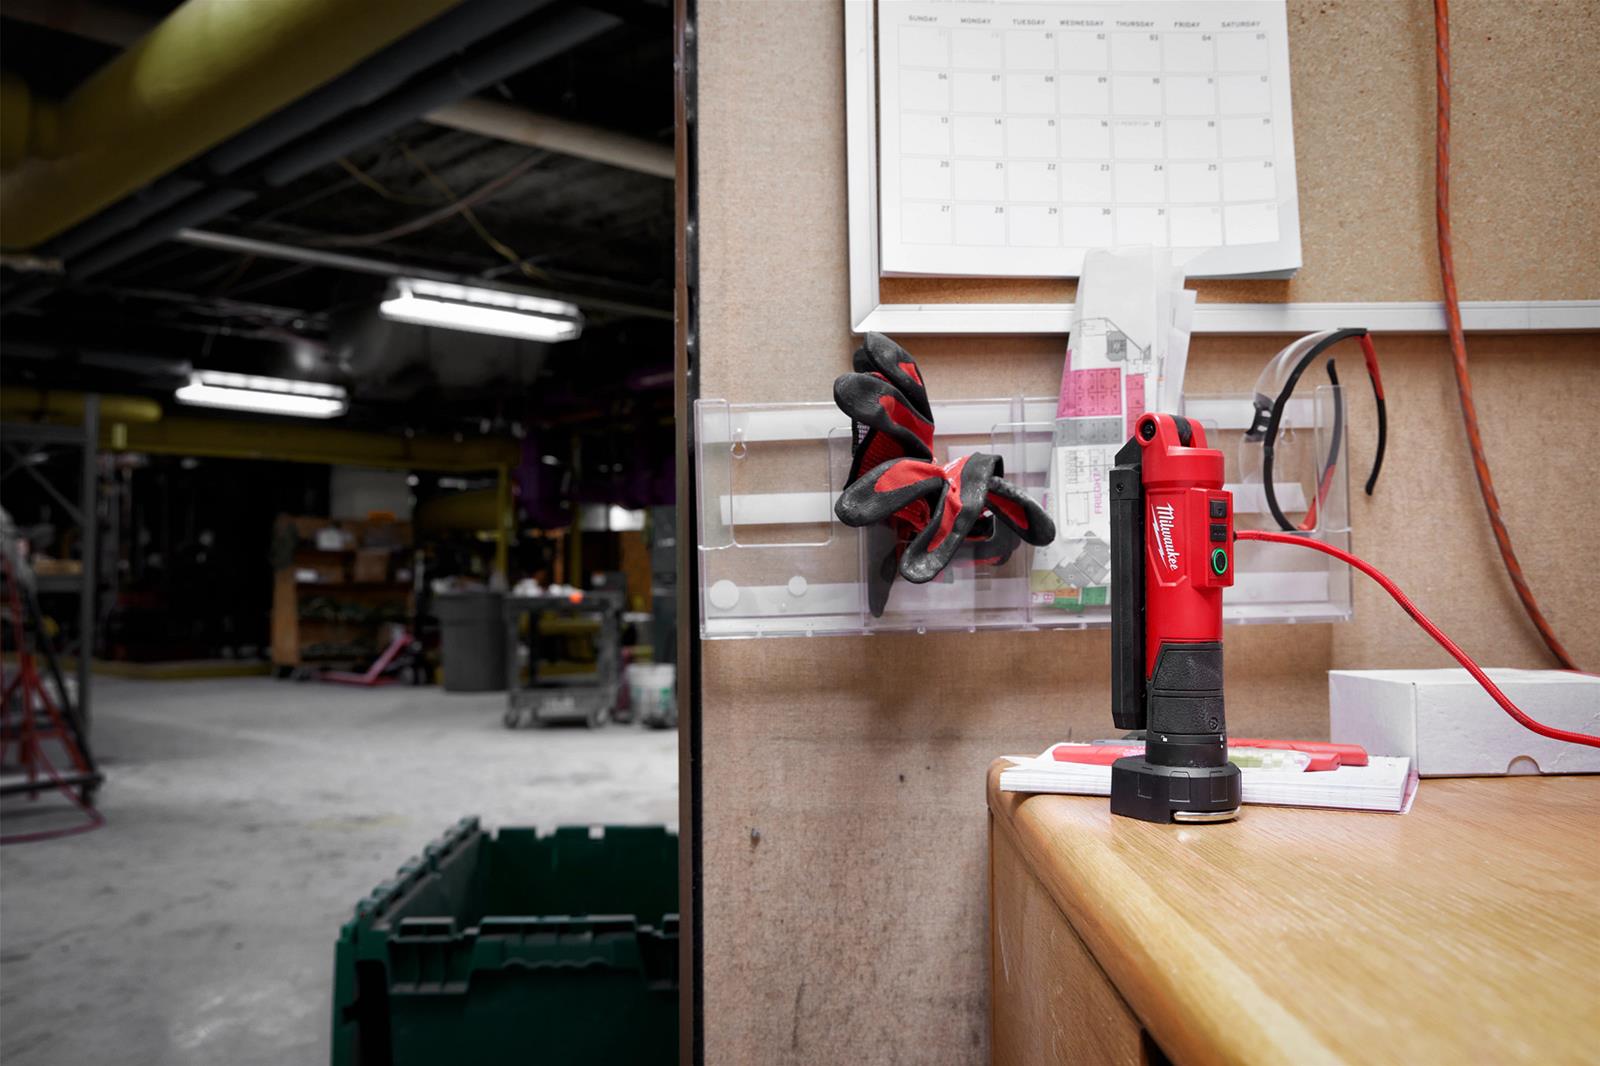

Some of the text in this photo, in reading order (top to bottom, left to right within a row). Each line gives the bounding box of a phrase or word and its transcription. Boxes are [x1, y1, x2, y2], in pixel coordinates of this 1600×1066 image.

[908, 14, 938, 22] SUNDAY
[960, 17, 991, 25] MONDAY
[1012, 18, 1046, 26] TUESDAY
[1059, 19, 1104, 27] WEDNESDAY
[1115, 20, 1155, 28] THURSDAY
[1044, 32, 1054, 40] 01
[1201, 34, 1212, 42] 04
[937, 72, 948, 81] 06
[991, 74, 1001, 82] 07
[1044, 75, 1054, 83] 08
[1097, 76, 1108, 84] 09
[940, 116, 949, 124] 13
[1047, 119, 1056, 127] 15
[939, 160, 950, 168] 20
[995, 162, 1004, 170] 21
[1047, 163, 1057, 171] 22
[1100, 163, 1110, 172] 23
[1153, 164, 1163, 172] 24
[1207, 163, 1217, 172] 25
[940, 204, 950, 213] 27
[994, 206, 1004, 214] 28
[1047, 207, 1058, 215] 29
[1101, 207, 1112, 216] 30
[1155, 502, 1180, 571] Milwaukee
